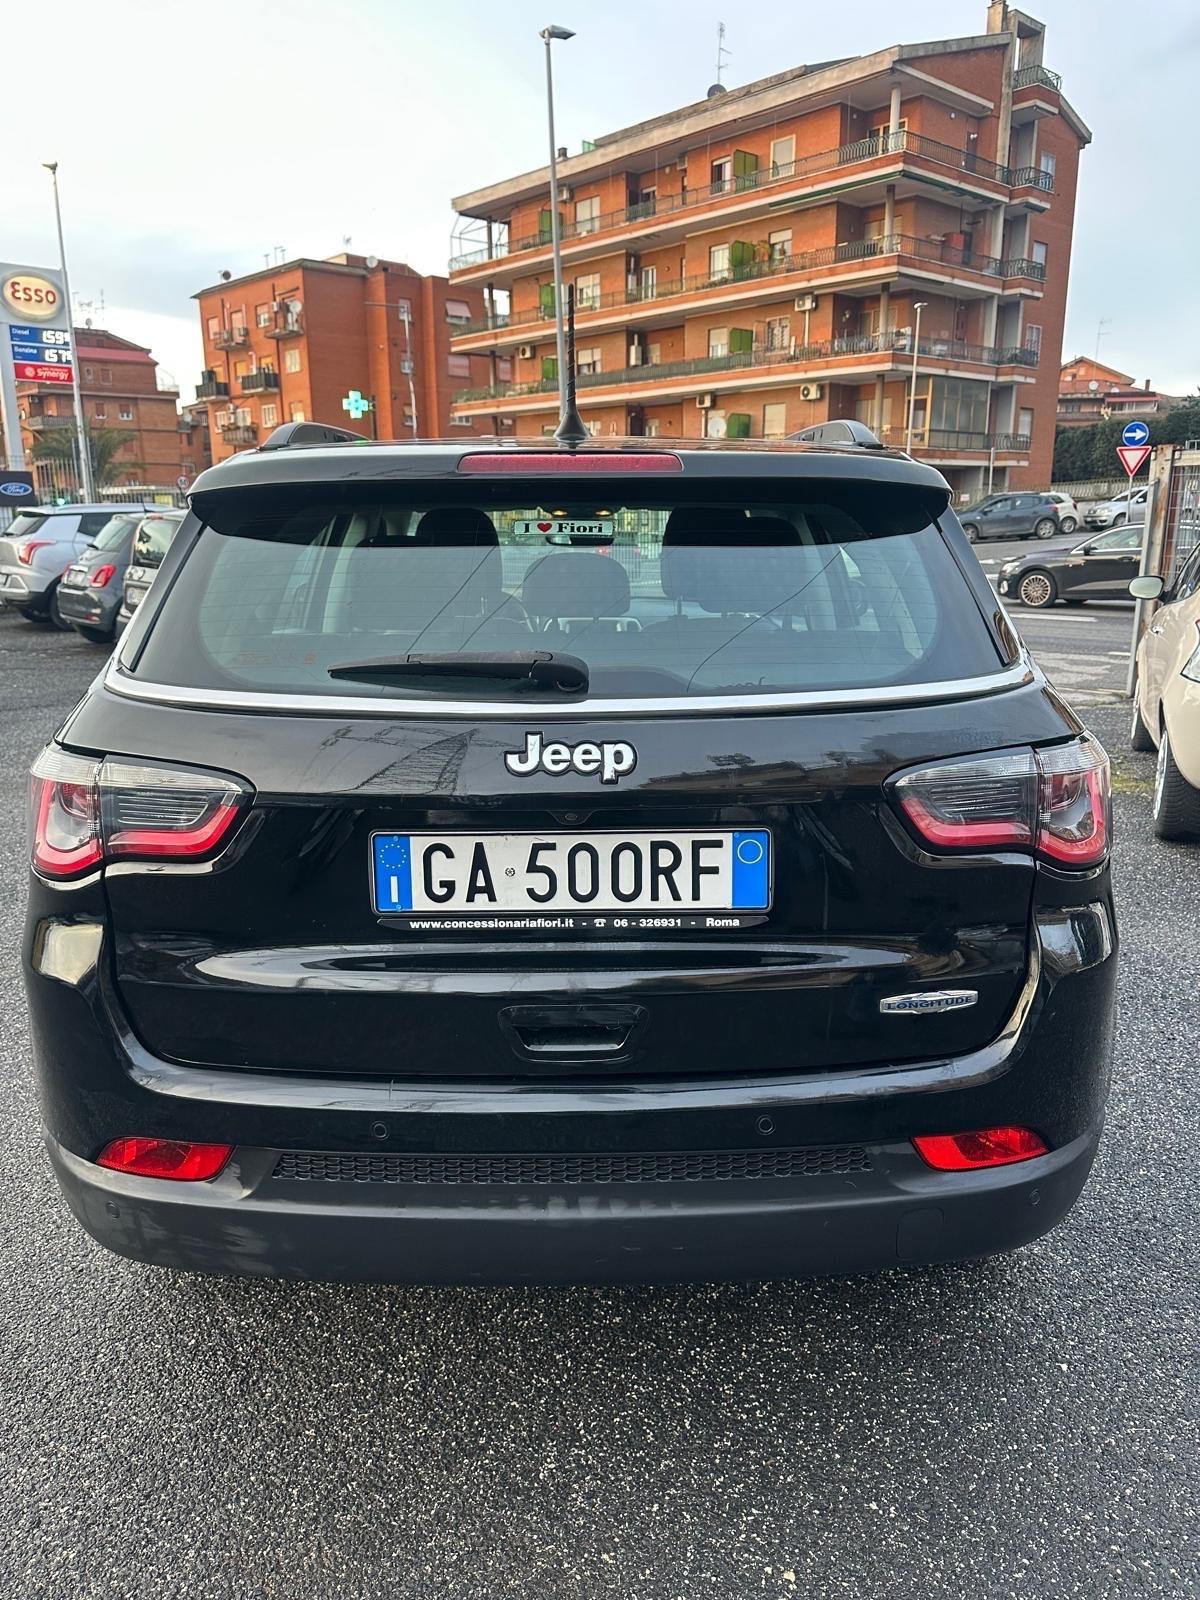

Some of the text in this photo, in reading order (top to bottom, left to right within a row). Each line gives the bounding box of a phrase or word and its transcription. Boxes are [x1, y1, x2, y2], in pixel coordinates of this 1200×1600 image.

[11, 327, 30, 336] Diesel
[14, 345, 38, 354] Benzina
[36, 367, 69, 380] Synergy
[524, 523, 603, 533] I Fiori
[504, 731, 637, 784] Jeep
[422, 839, 724, 904] GA 500RF
[409, 918, 574, 929] www.concessionariafiori.it
[613, 918, 628, 928] 06
[639, 918, 682, 927] 326931
[706, 917, 740, 927] Roma
[885, 995, 973, 1011] LONGITUDE
